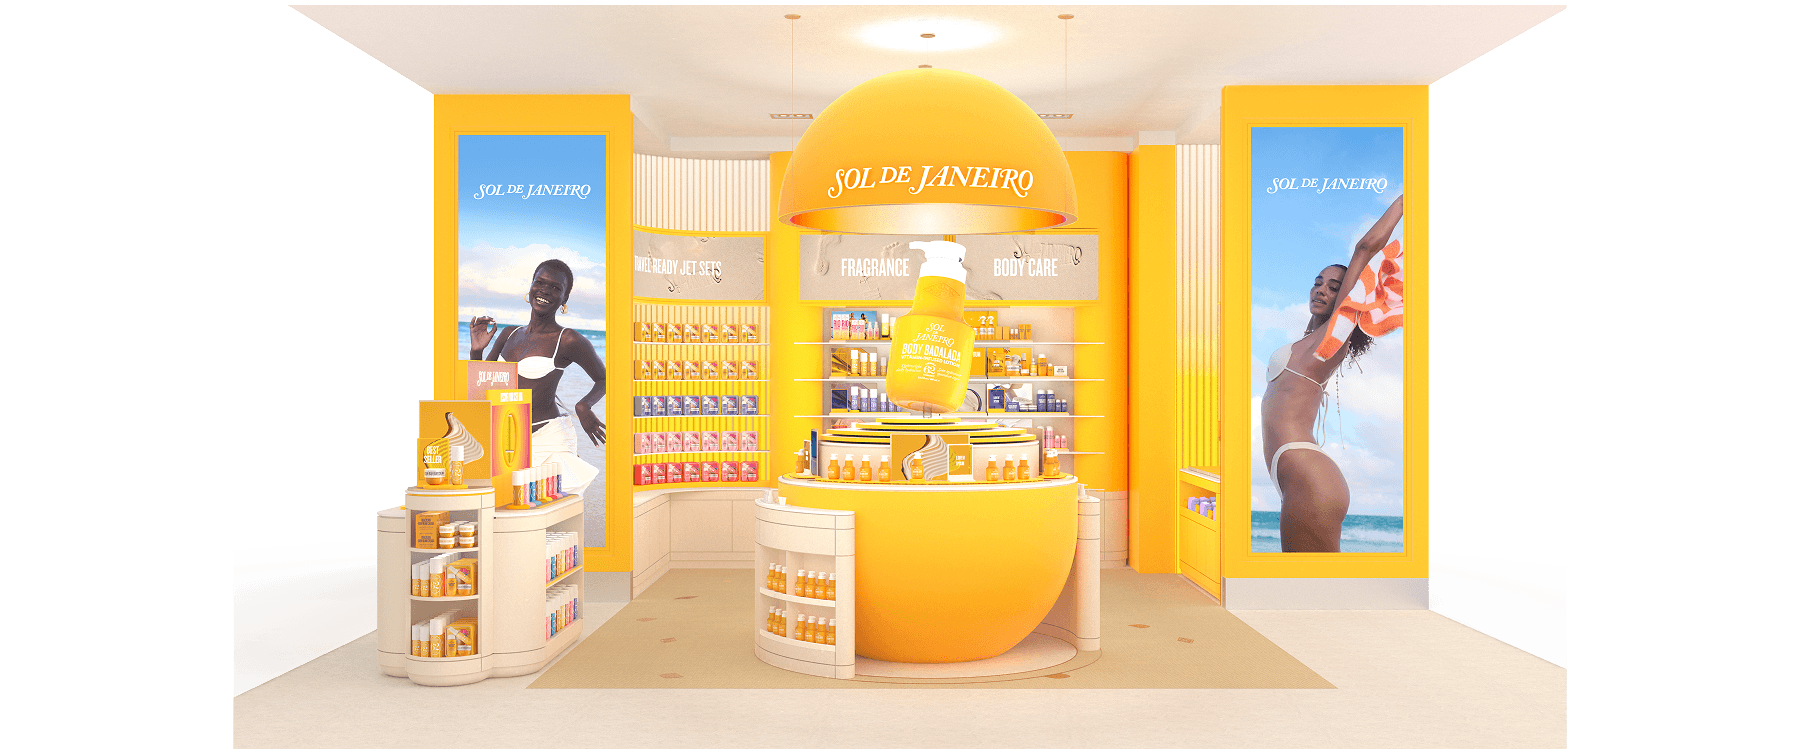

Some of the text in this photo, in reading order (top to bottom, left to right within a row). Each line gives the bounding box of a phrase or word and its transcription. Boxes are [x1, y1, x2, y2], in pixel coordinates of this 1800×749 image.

[827, 165, 1034, 198] SOL DE JANEIRO
[1266, 177, 1388, 194] SOL DE JANEIRO
[473, 184, 592, 200] SOL DE JANEIRO
[652, 257, 679, 275] READY
[680, 260, 698, 276] JET
[698, 260, 722, 277] SETS
[841, 258, 910, 277] FRAGRANCE
[993, 258, 1058, 277] BODY CARE
[925, 322, 945, 332] SOL
[912, 332, 955, 347] JANEIRO
[901, 343, 961, 363] BODY BADALADA
[426, 445, 440, 455] BEST
[423, 455, 442, 464] SELLER
